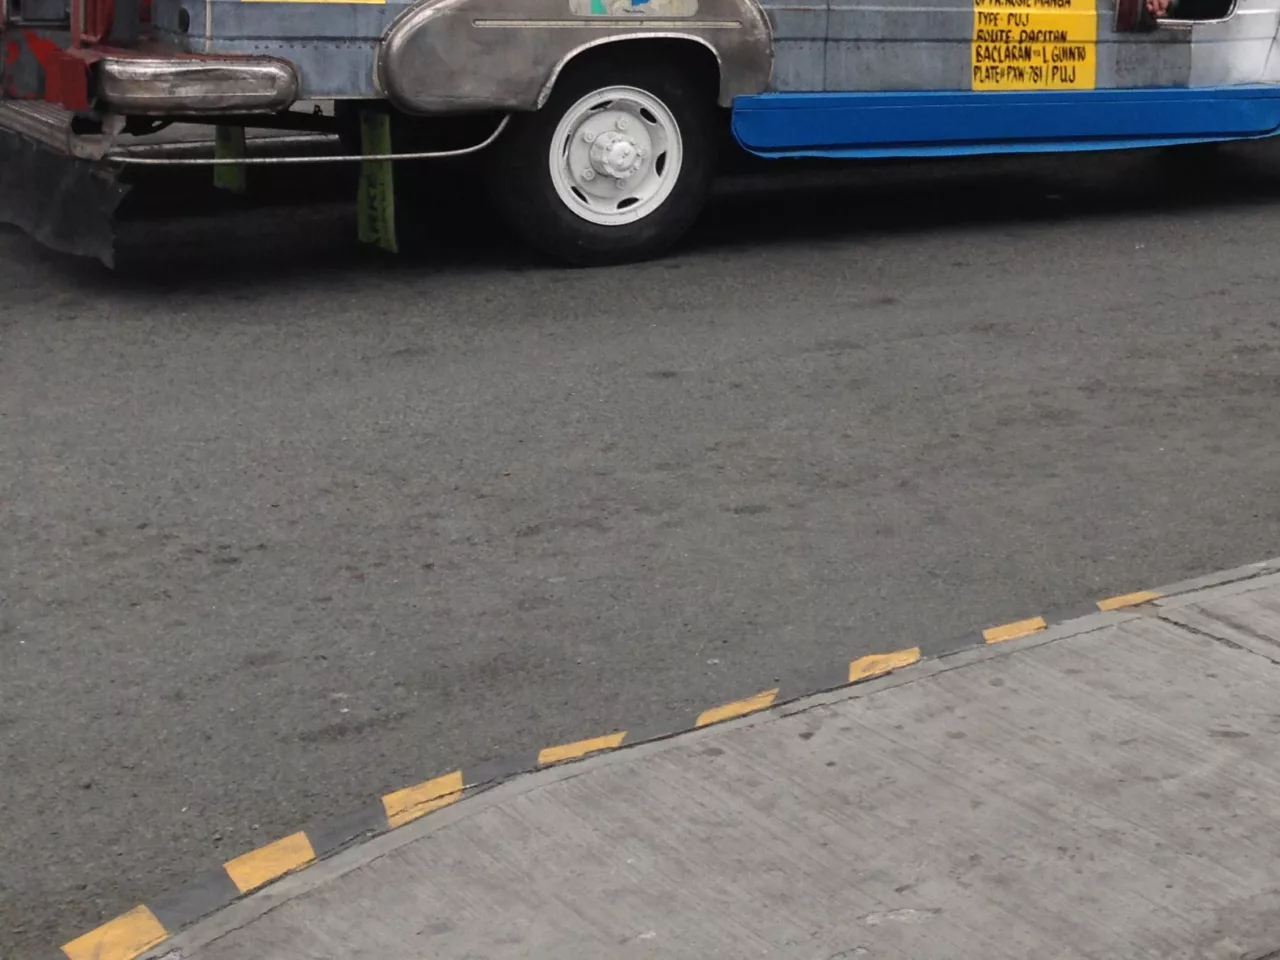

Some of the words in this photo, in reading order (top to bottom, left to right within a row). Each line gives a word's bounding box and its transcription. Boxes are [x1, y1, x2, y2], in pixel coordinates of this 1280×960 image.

[1007, 13, 1030, 27] PUJ
[975, 44, 1032, 64] BACLARAN
[1051, 65, 1076, 84] PUJ
